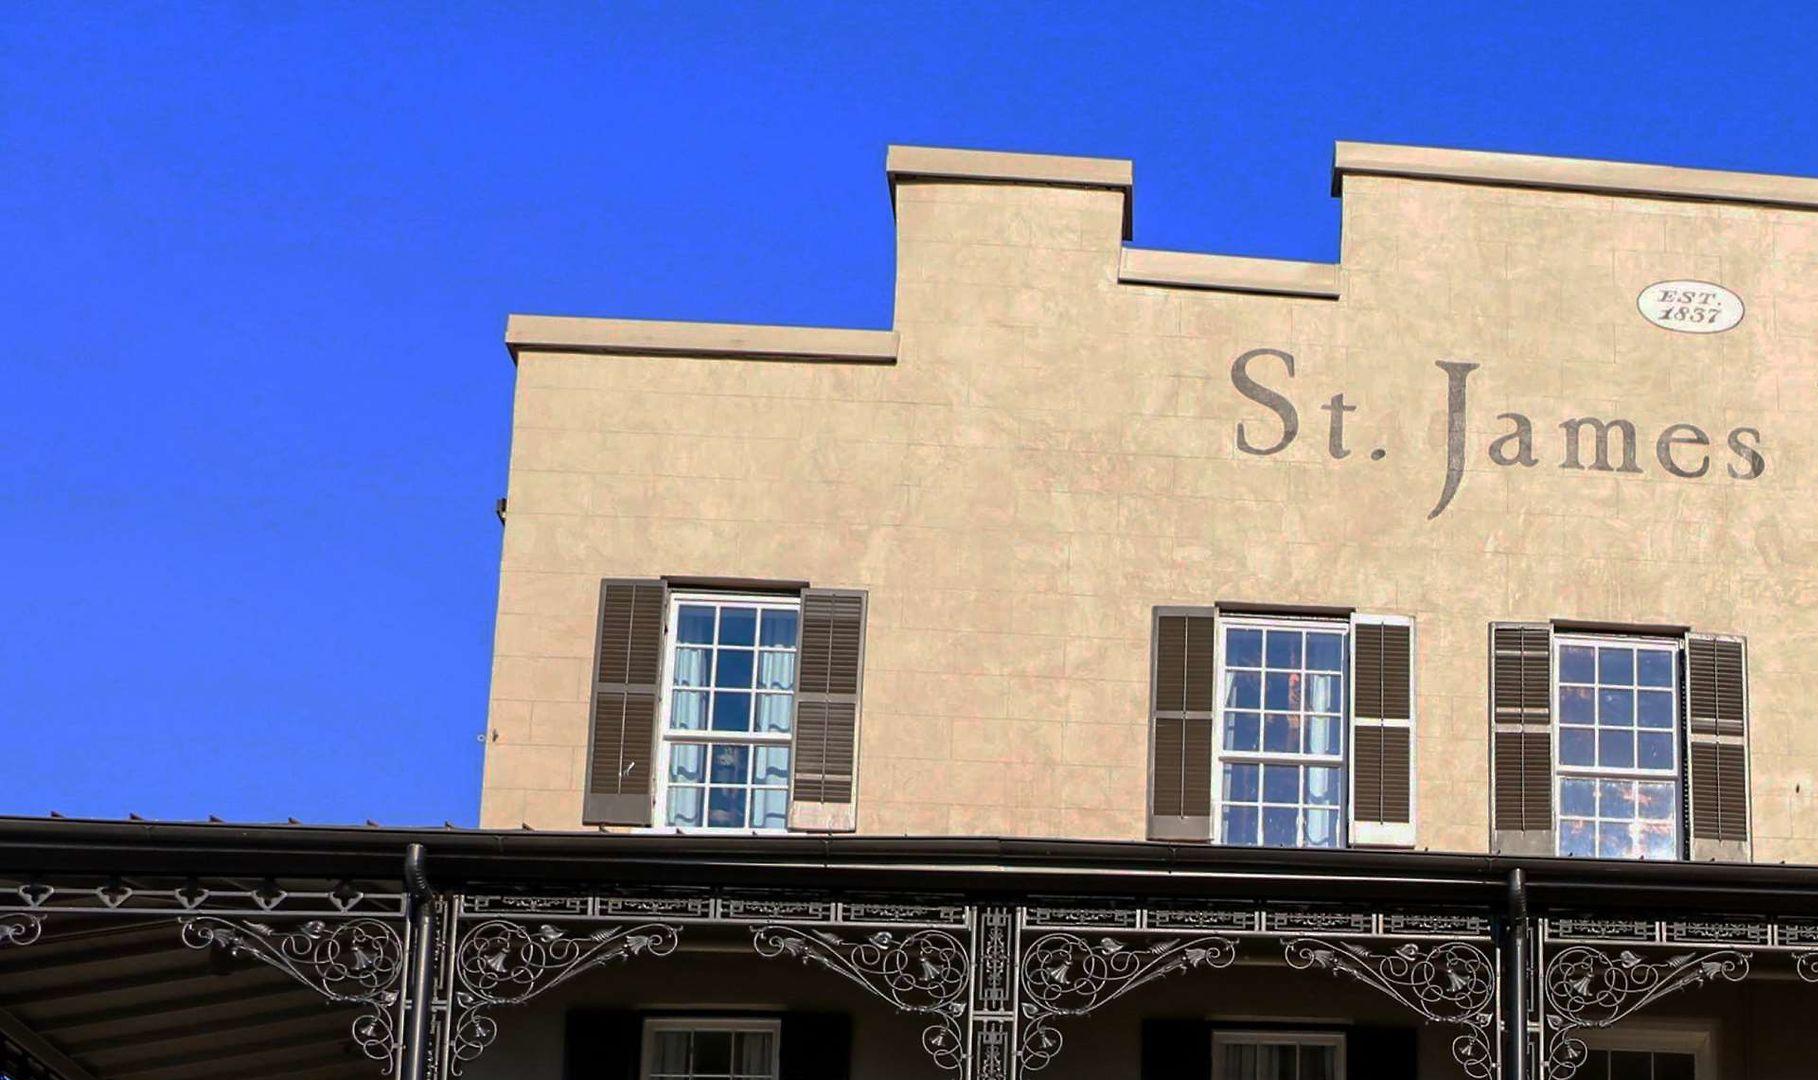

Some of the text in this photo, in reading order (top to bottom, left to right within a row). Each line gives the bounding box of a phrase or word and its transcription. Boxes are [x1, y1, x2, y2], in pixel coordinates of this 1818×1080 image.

[1658, 289, 1722, 306] EST.
[1658, 306, 1721, 324] 1837
[1230, 347, 1388, 463] St.
[1427, 360, 1765, 521] James
